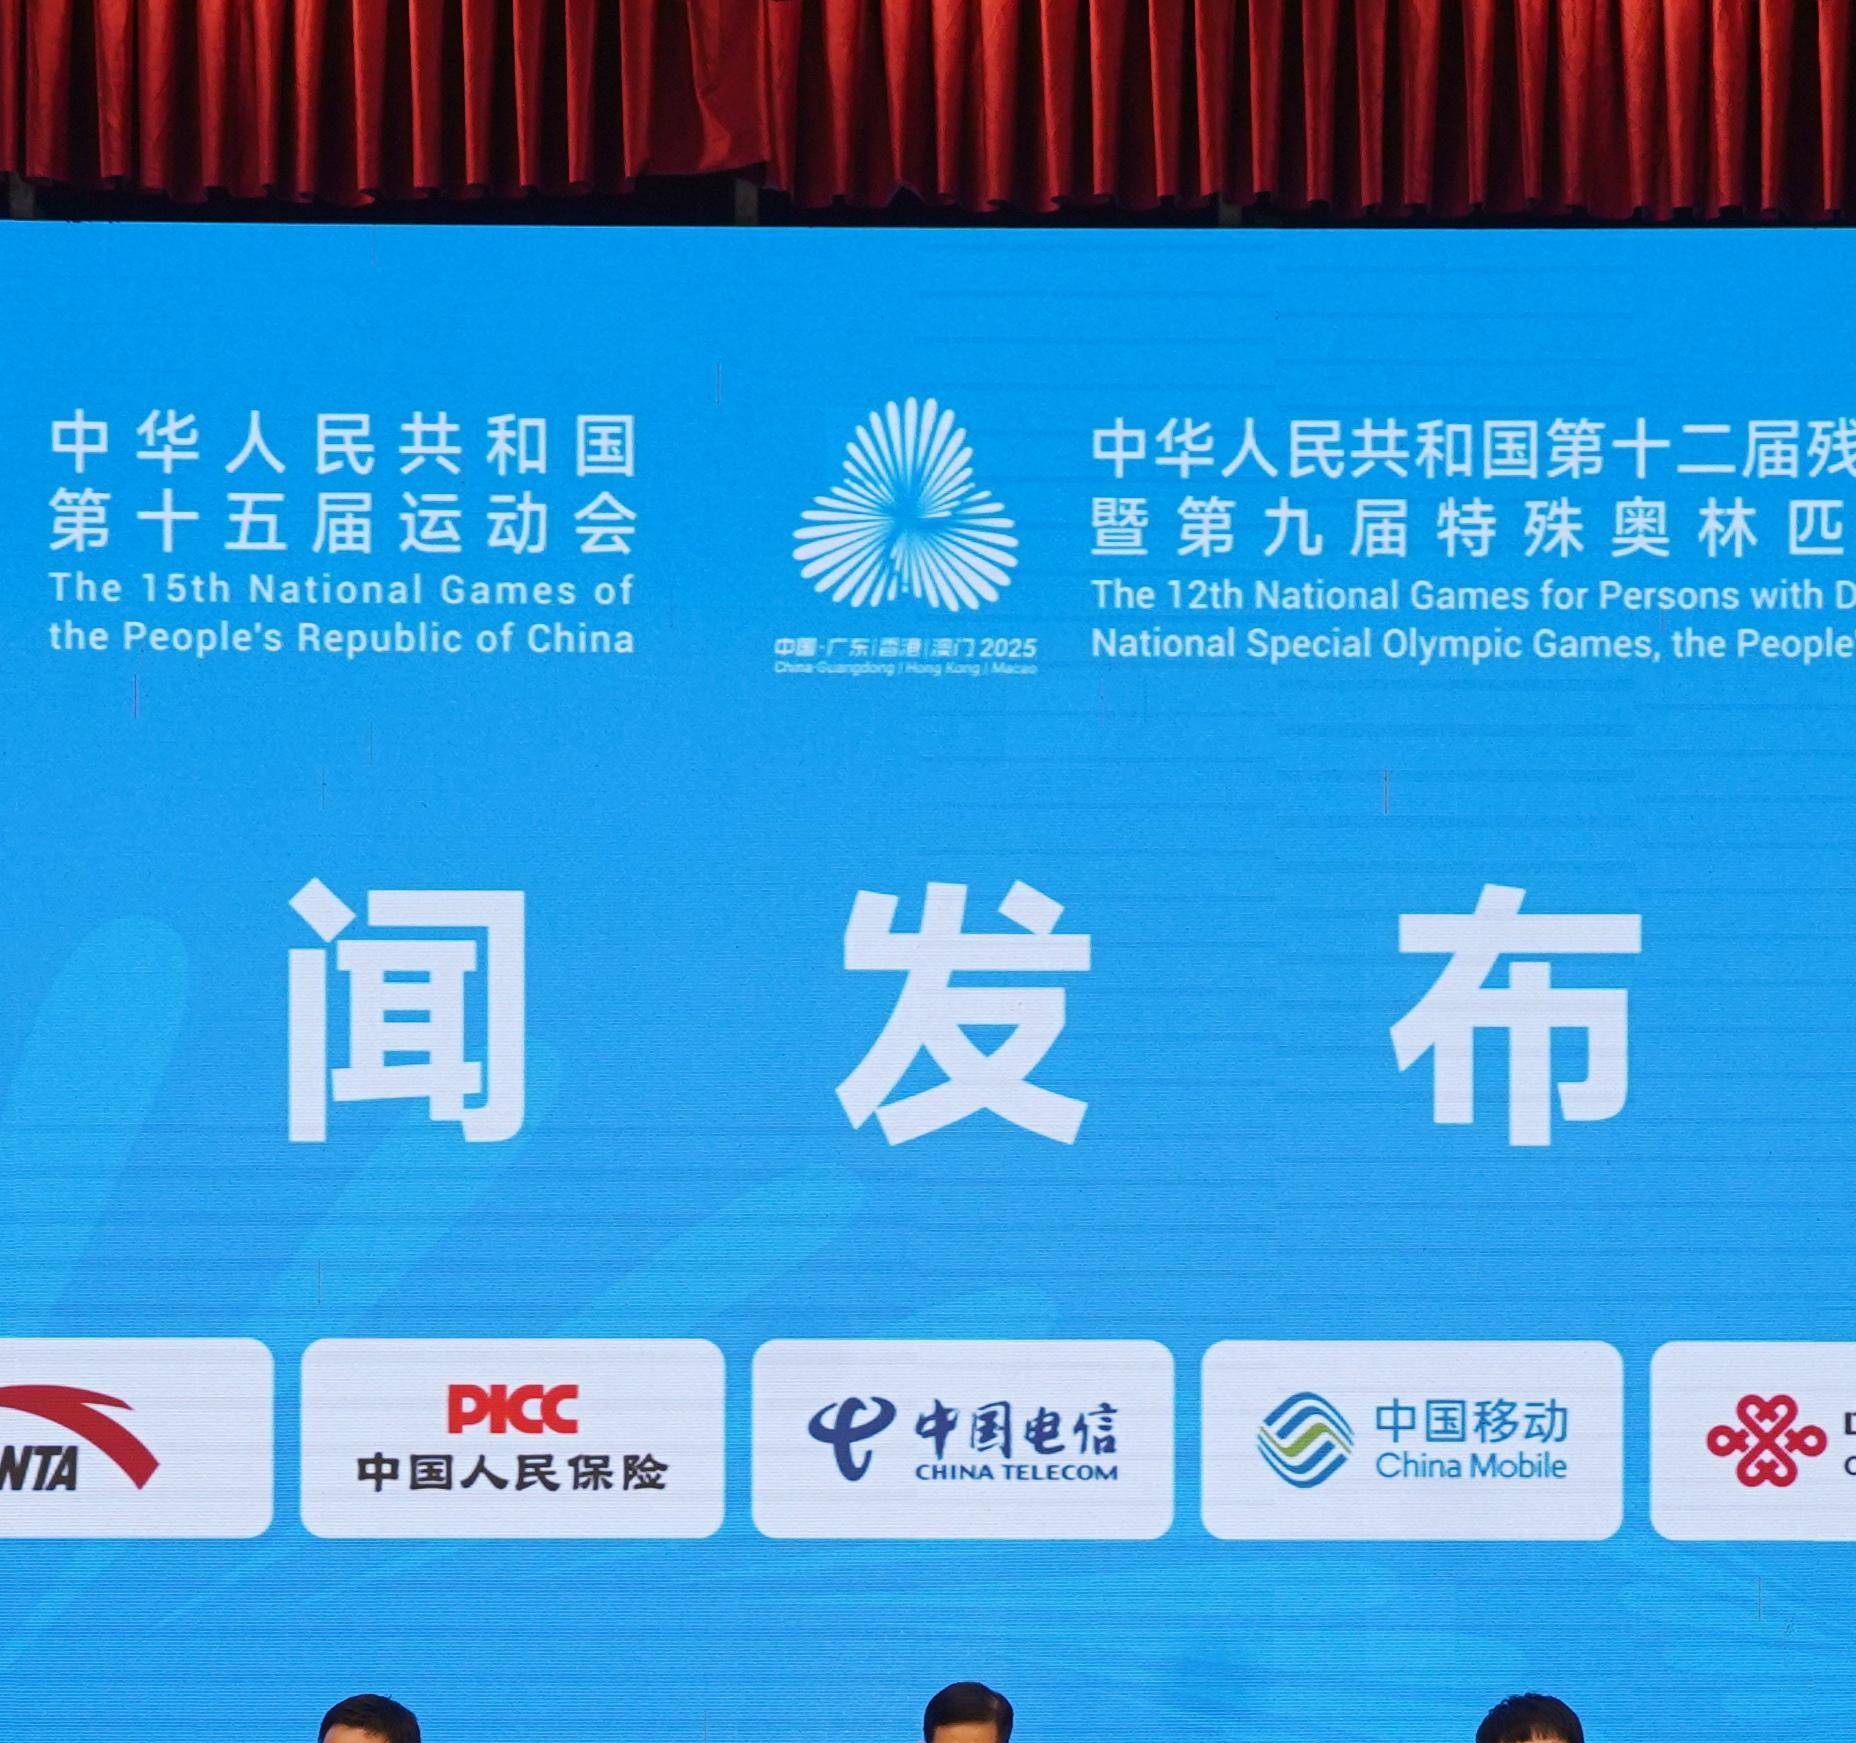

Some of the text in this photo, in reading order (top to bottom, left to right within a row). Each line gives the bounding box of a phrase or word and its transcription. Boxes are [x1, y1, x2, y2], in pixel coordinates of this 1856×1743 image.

[51, 408, 636, 478] 中华人民共和国
[48, 486, 638, 556] 第十五届运动会
[48, 570, 635, 606] The 15th National Games of
[1090, 577, 1156, 610] The
[1167, 578, 1243, 610] 12th
[1254, 578, 1399, 611] National
[1410, 579, 1530, 611] Games
[1539, 577, 1589, 611] for
[1599, 579, 1740, 611] Persons
[1750, 578, 1824, 610] with
[48, 619, 635, 660] the People's Republic of China
[979, 637, 1038, 659] 2025
[1092, 626, 1236, 658] National
[1246, 626, 1372, 665] Special
[1382, 627, 1523, 667] Olympic
[1532, 627, 1661, 662] Games,
[1671, 626, 1727, 659] the
[447, 1383, 579, 1435] PICC
[915, 1398, 1119, 1461] 中国电信
[1376, 1397, 1569, 1444] 中国移动
[356, 1451, 670, 1493] 中国人民保险
[915, 1464, 1119, 1481] CHINA TELECOM
[1375, 1450, 1568, 1479] China Mobile
